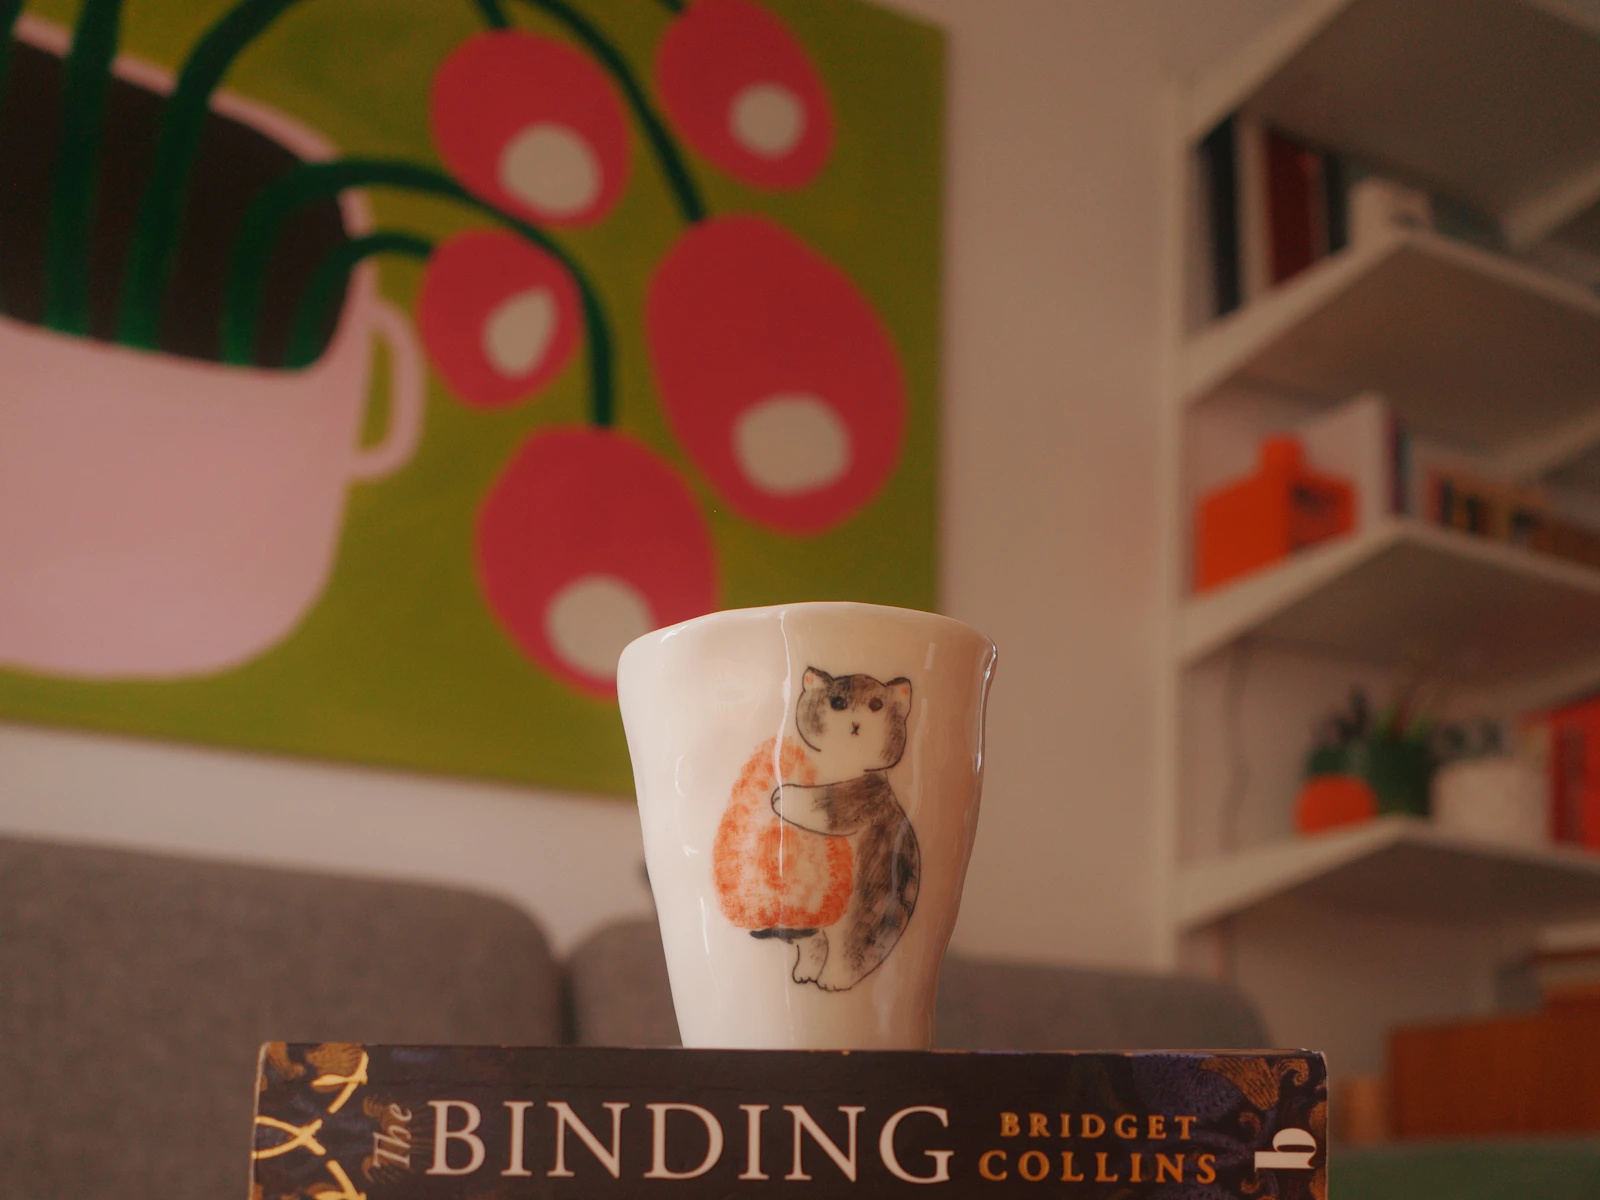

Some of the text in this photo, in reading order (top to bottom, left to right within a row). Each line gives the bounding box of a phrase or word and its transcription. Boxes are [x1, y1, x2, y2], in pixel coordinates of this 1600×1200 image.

[371, 1099, 955, 1184] The BINDING
[1001, 1112, 1198, 1140] BRIDGET
[978, 1149, 1218, 1184] COLLINS
